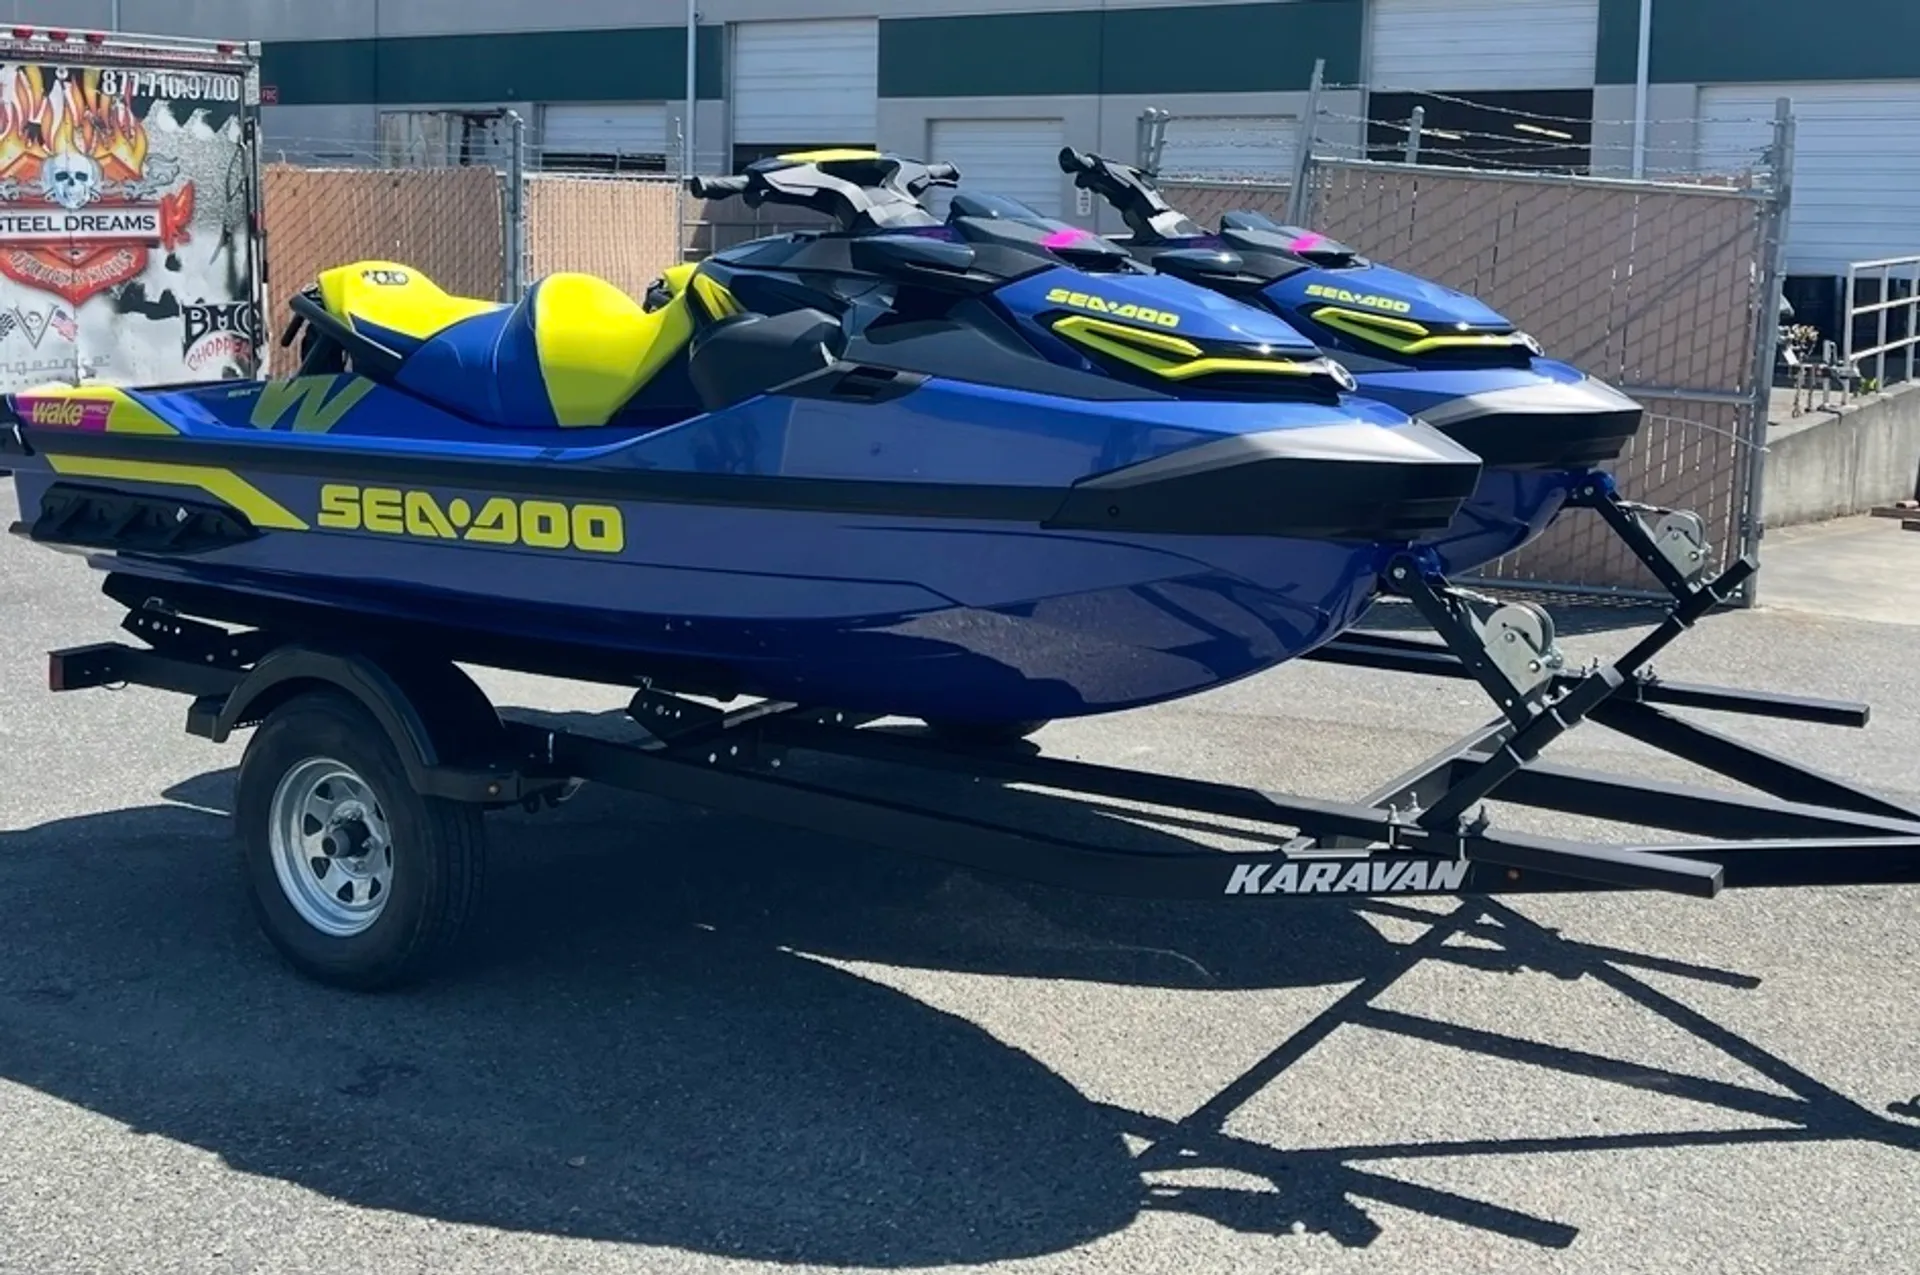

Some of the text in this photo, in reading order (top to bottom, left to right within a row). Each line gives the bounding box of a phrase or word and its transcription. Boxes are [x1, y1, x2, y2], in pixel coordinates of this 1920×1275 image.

[0, 215, 156, 233] TEEL DREAMS
[32, 397, 83, 426] wake
[1224, 860, 1470, 894] KARAVAN
